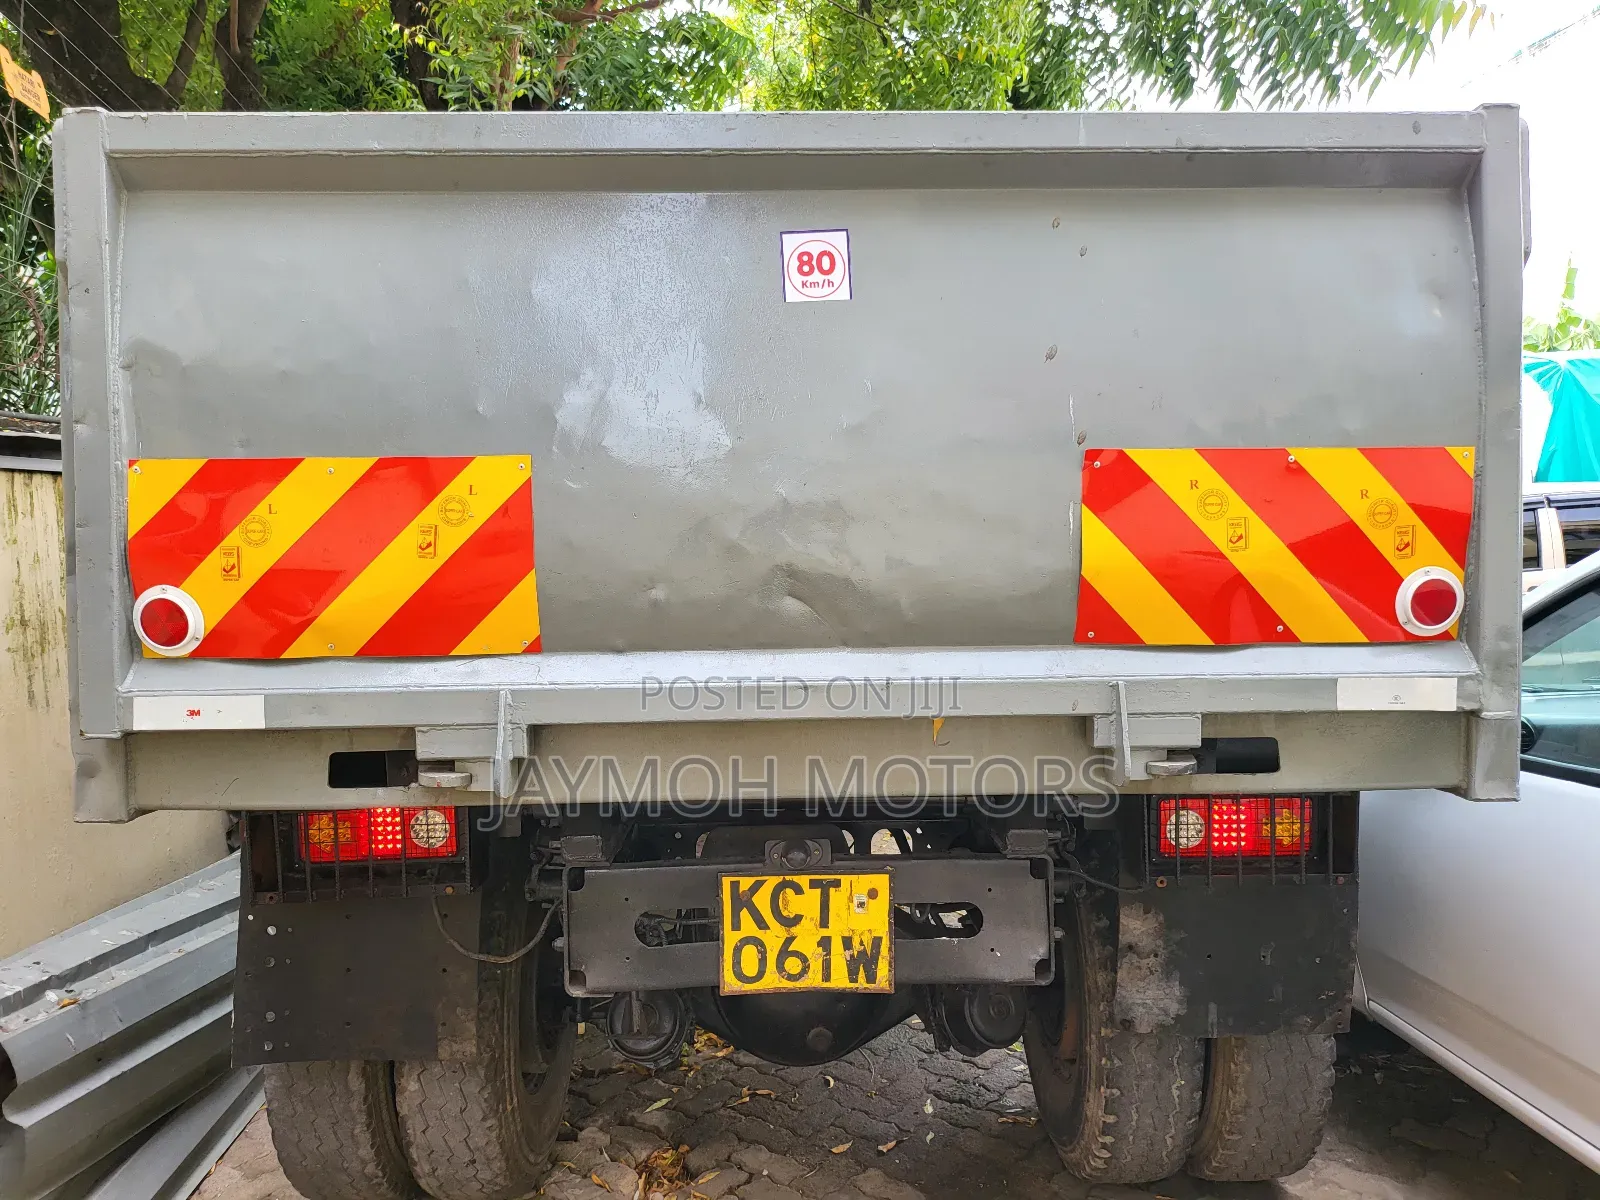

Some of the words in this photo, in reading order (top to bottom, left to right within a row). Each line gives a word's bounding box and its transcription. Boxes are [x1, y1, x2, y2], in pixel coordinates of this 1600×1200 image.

[797, 250, 836, 277] 80
[801, 278, 835, 289] Km/h
[468, 484, 478, 496] L
[1189, 479, 1199, 490] R
[1360, 488, 1370, 500] R
[268, 503, 278, 515] L
[186, 709, 200, 717] 3M
[730, 879, 842, 931] KCT
[732, 936, 883, 985] 061W
